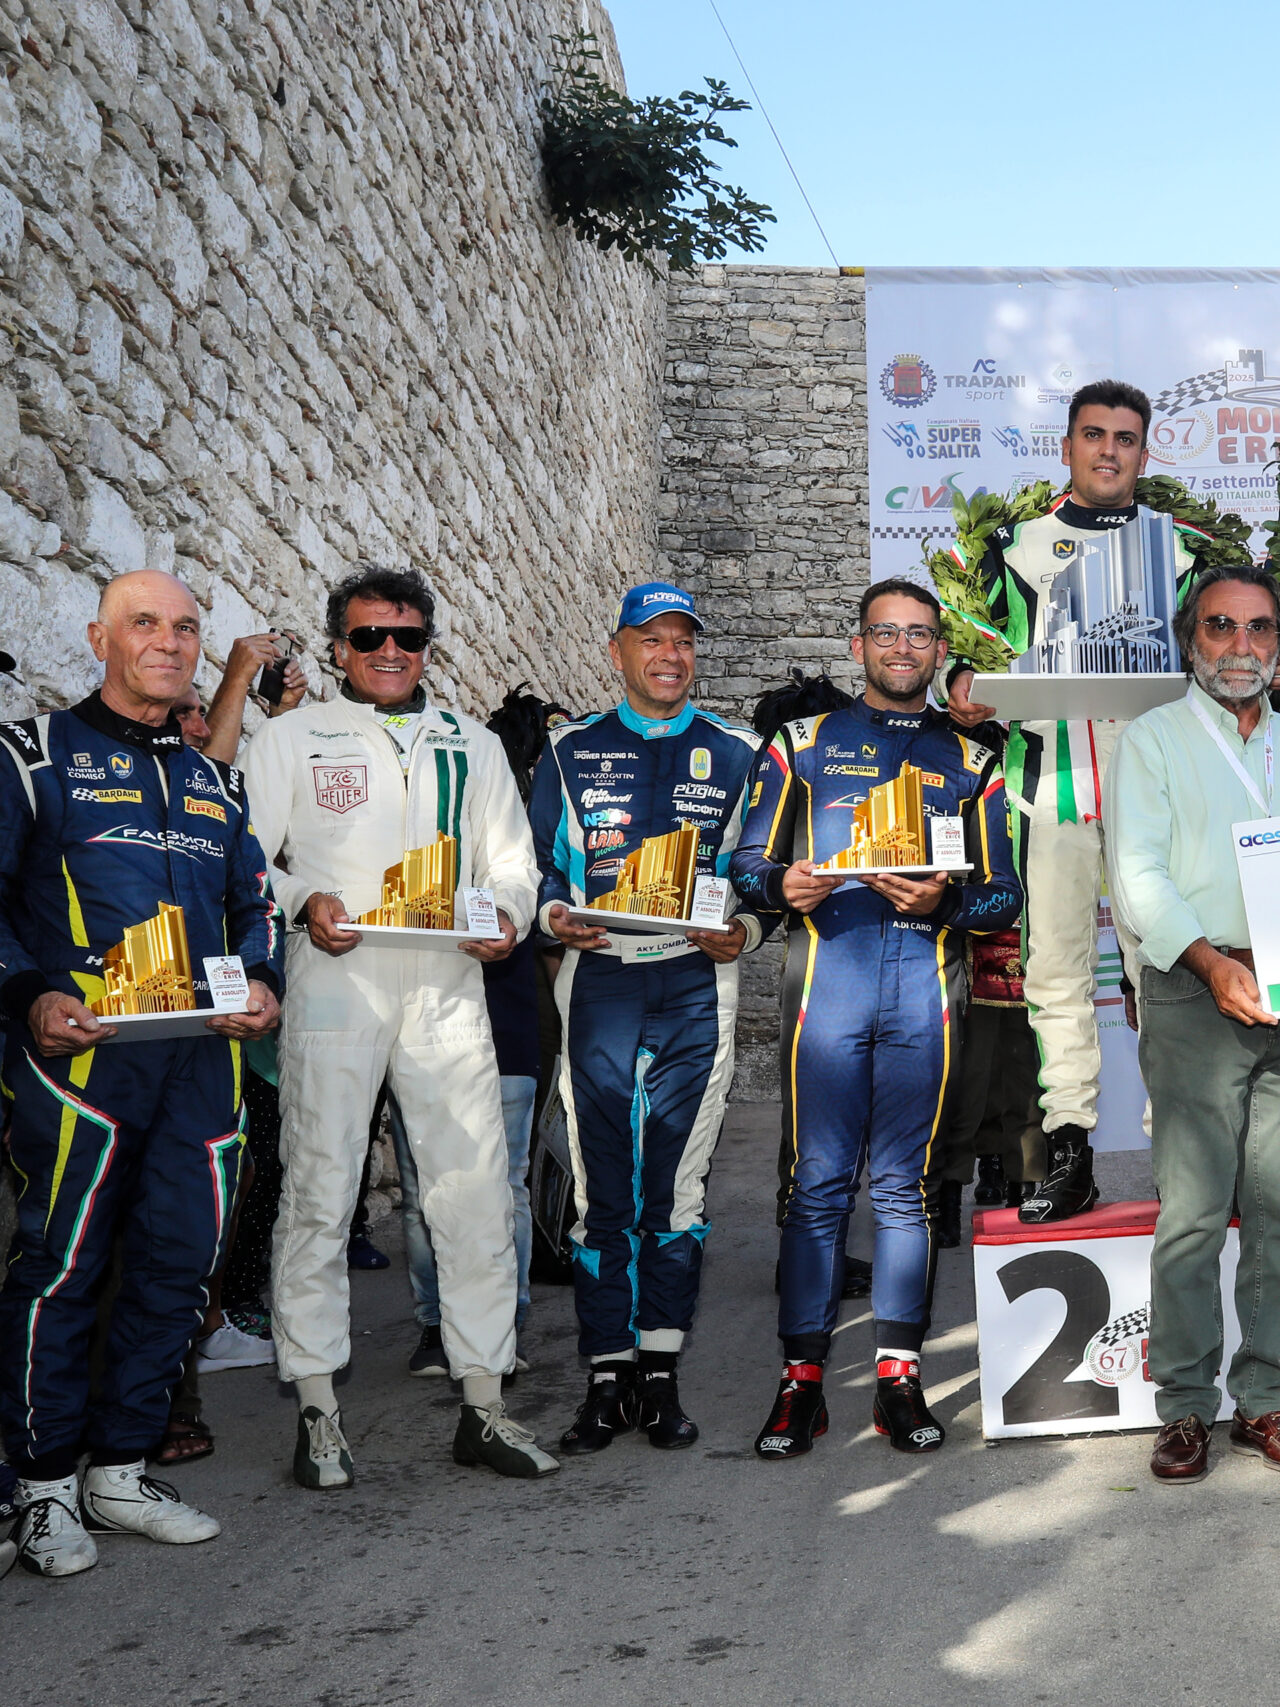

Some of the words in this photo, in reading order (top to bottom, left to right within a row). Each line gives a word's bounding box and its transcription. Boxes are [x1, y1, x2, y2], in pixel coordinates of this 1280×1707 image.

[943, 375, 1026, 388] TRAPANI
[1228, 374, 1254, 382] 2025
[965, 389, 1005, 402] sport
[1030, 422, 1068, 430] Campionat
[927, 427, 981, 444] SUPER
[928, 444, 981, 460] SALITA
[1202, 474, 1276, 489] settemb
[1226, 490, 1271, 500] ITALIANO
[1096, 515, 1128, 524] HRX
[888, 719, 922, 728] HRX
[68, 772, 106, 780] COMISO
[845, 766, 876, 774] BARDAHL
[324, 769, 357, 788] TAG
[98, 791, 139, 800] BARDAHL
[322, 789, 362, 807] HEUER
[673, 784, 727, 799] Puglia
[186, 798, 226, 821] PIRELLI
[672, 800, 723, 817] Telcom
[123, 828, 224, 852] FAGGIOLI
[911, 922, 932, 931] CARO
[996, 1250, 1120, 1426] 2
[912, 1429, 941, 1443] OMP
[760, 1438, 791, 1449] OMP
